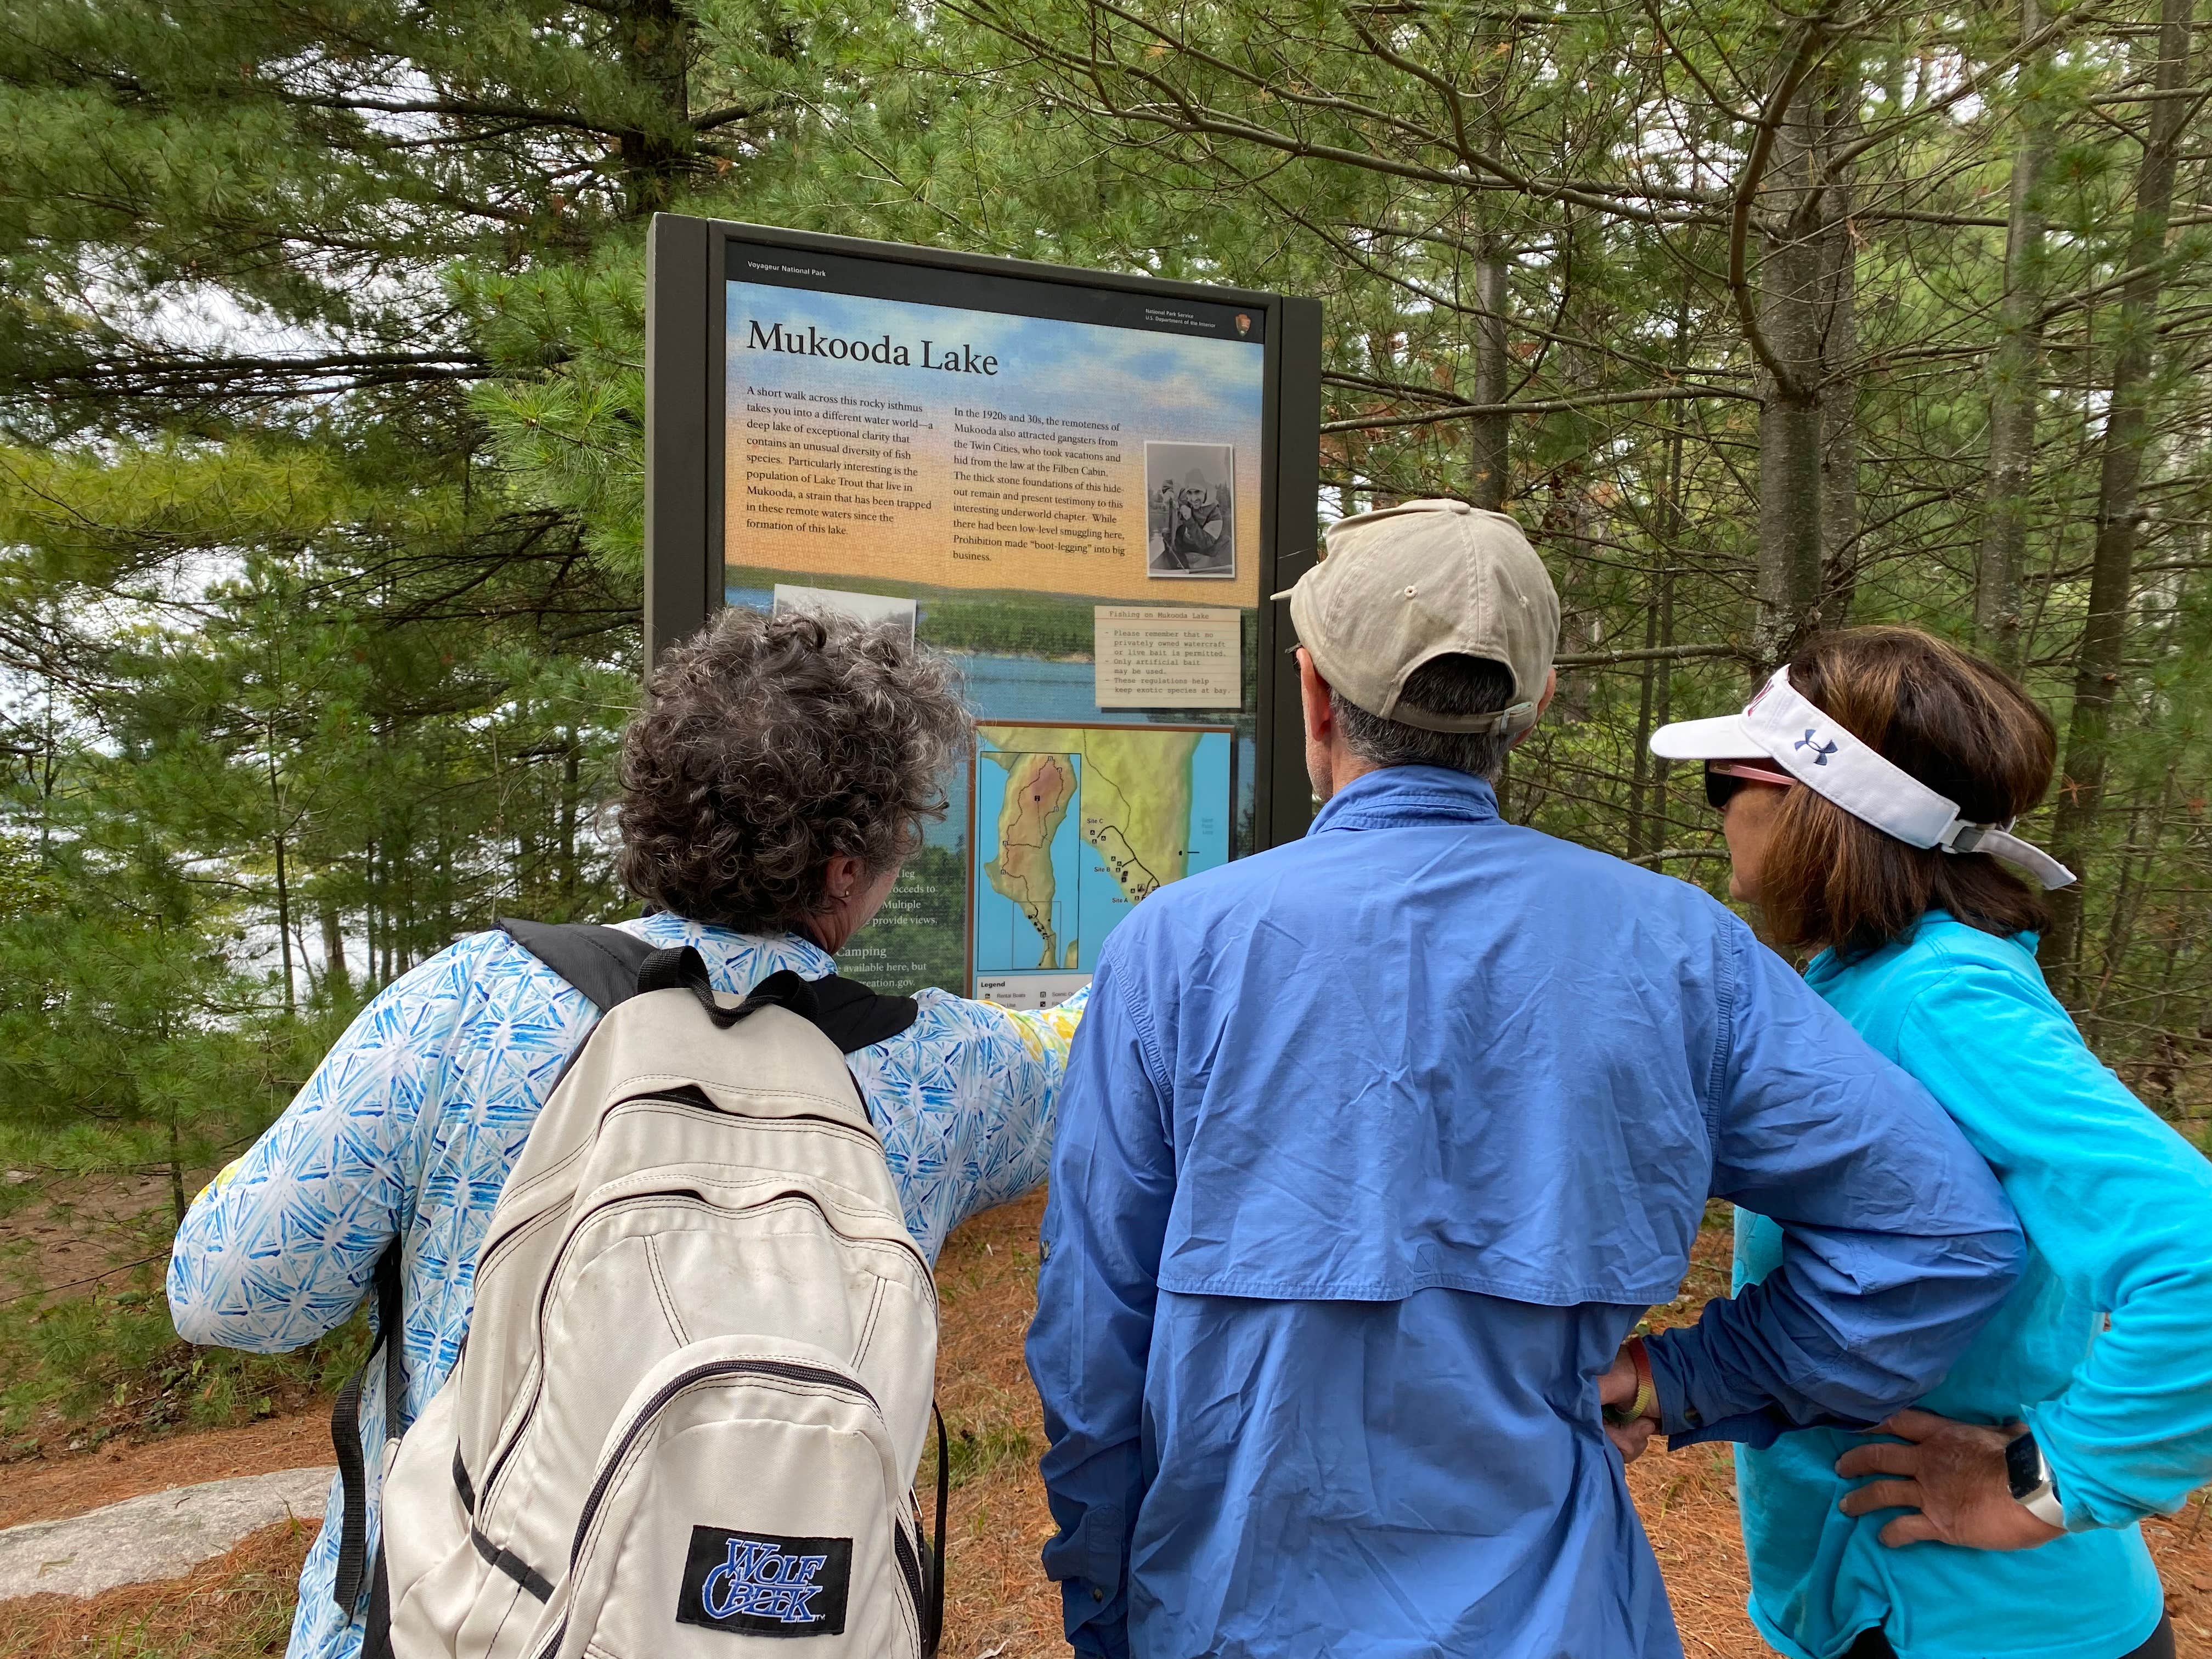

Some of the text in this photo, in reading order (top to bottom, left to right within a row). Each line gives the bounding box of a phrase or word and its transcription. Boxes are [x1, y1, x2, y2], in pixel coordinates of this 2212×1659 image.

[748, 261, 780, 270] Voyageur
[782, 266, 809, 274] National
[746, 320, 998, 375] Mukooda Lake
[747, 386, 923, 412] A short walk across this rocky isthmus
[747, 403, 770, 413] takes
[773, 408, 790, 416] you
[794, 408, 812, 417] into
[822, 410, 861, 422] different
[865, 416, 889, 425] water
[954, 408, 1109, 430] In 1920s 30s, remoteness
[747, 420, 910, 443] deep lake exceptional clarity that
[955, 424, 1118, 447] Mukooda also attracted gangsters from
[747, 438, 911, 460] contains unusual diversity fish
[969, 441, 1103, 461] Twin Cities, who took vacations
[747, 454, 891, 476] species. Particularly interesting
[954, 455, 1108, 477] hid from law Filben Cabin.
[747, 471, 901, 490] population Lake Trout that live
[954, 471, 970, 481] The
[974, 473, 995, 483] thick
[1023, 477, 1073, 489] foundations
[1086, 483, 1101, 491] this
[1103, 484, 1124, 493] hide-
[747, 486, 931, 511] Mukooda, strain that has been trapped
[970, 490, 1000, 499] remain
[1055, 497, 1096, 508] testimony
[759, 504, 877, 521] these remote waters since
[953, 503, 1116, 523] interesting underworld chapter. While
[747, 519, 848, 535] formation this lake.
[953, 520, 1124, 540] there had been low-level smuggling here,
[953, 534, 1002, 547] Prohibition
[1005, 539, 1028, 548] made
[1113, 547, 1125, 557] big
[953, 550, 992, 561] business.
[890, 885, 923, 893] oceeds
[882, 900, 921, 911] Multiple
[873, 916, 907, 927] provide
[837, 946, 887, 958] Camping
[844, 963, 884, 972] available
[887, 963, 909, 972] here,
[725, 1538, 828, 1585] WOLF
[702, 1562, 823, 1623] CREEK
